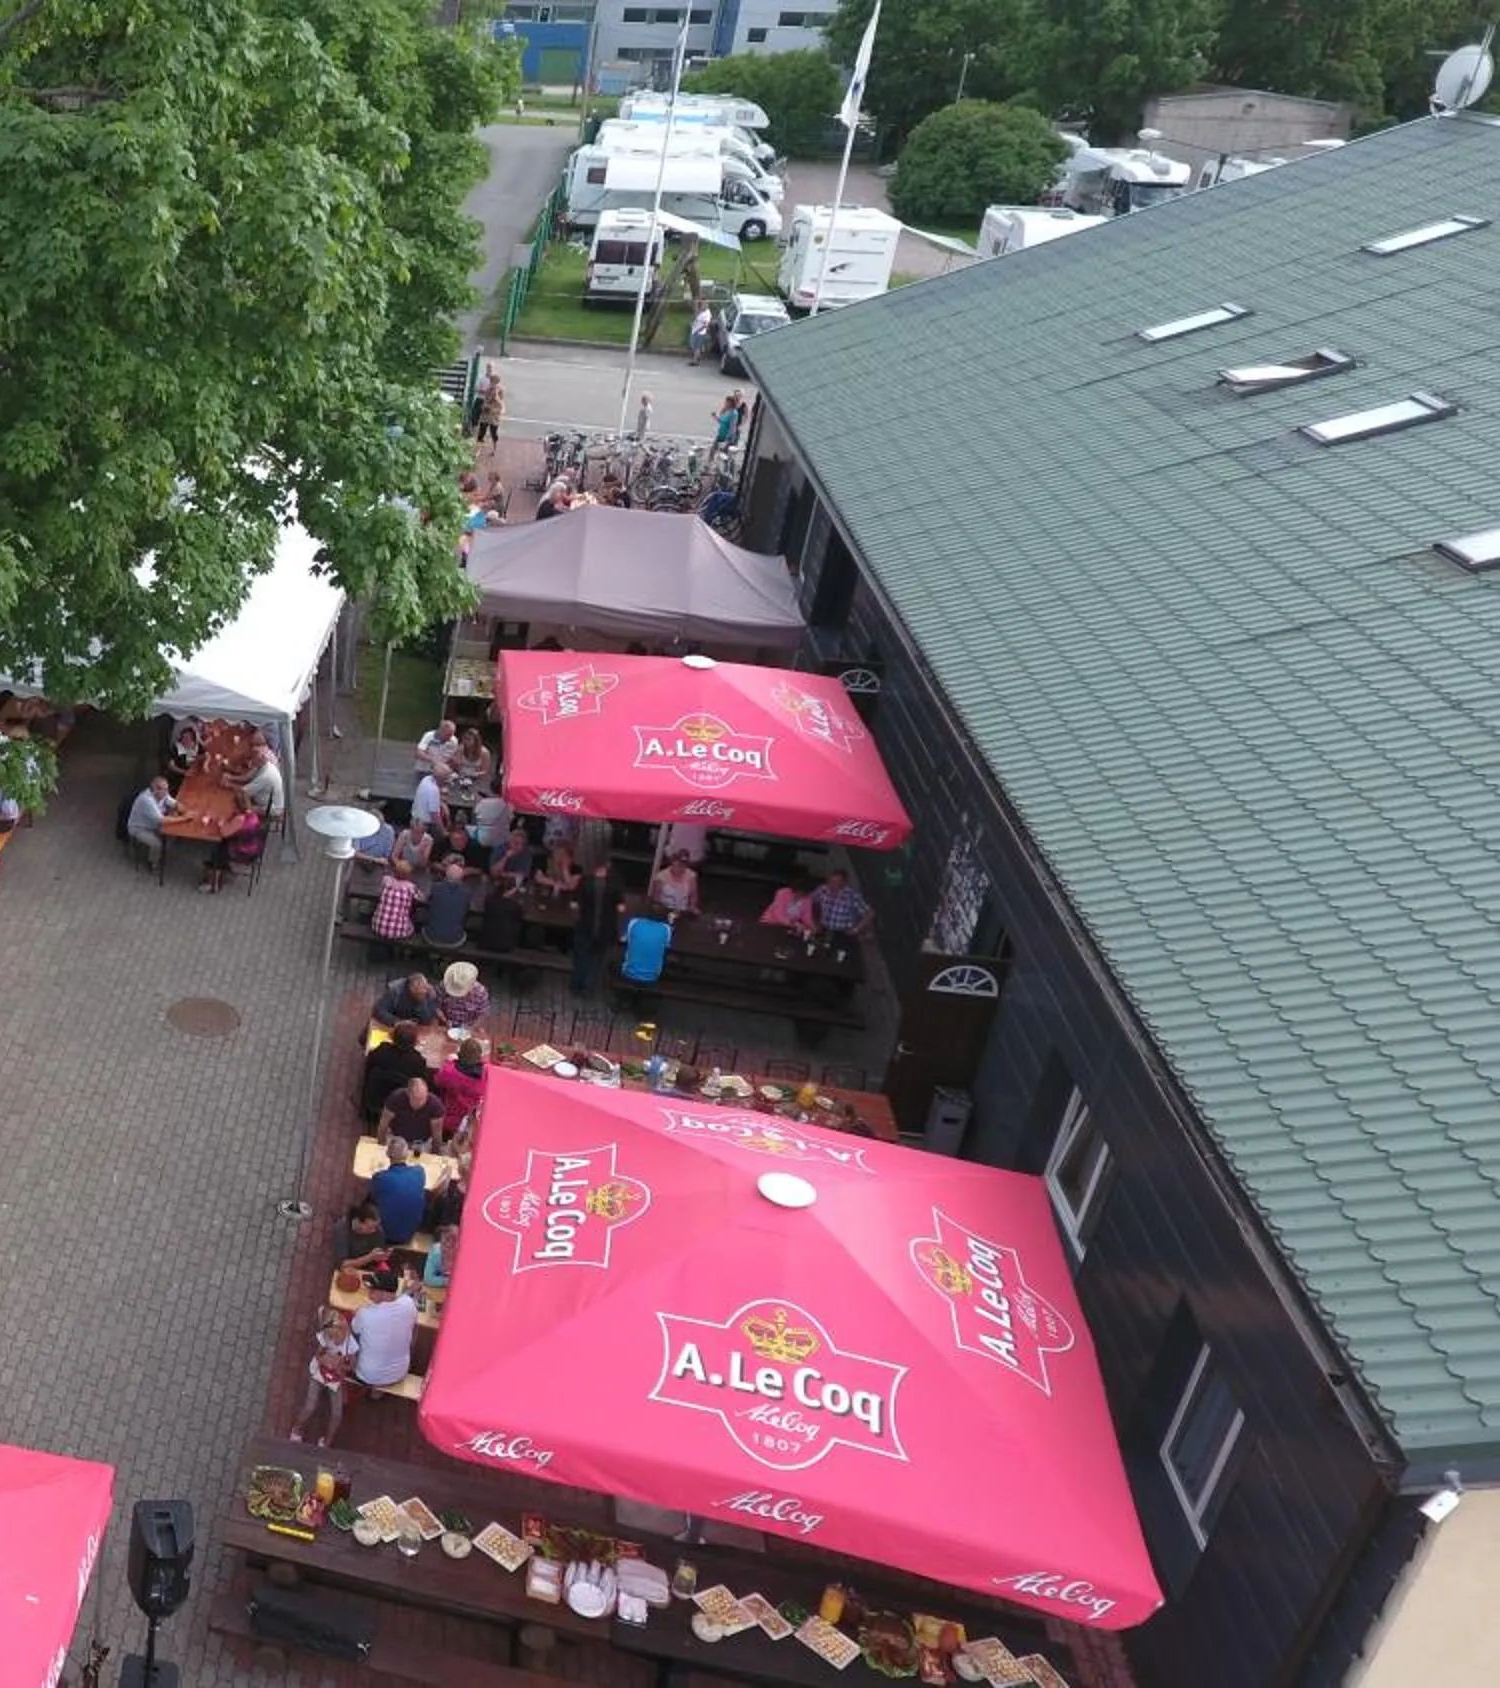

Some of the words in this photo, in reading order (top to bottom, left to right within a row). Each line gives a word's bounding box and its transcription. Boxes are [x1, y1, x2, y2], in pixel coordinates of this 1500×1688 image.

[712, 742, 762, 769] Coq
[533, 1209, 587, 1259] Coq
[672, 1342, 785, 1400] A.Le
[793, 1366, 884, 1435] Coq
[752, 1431, 802, 1455] 1807
